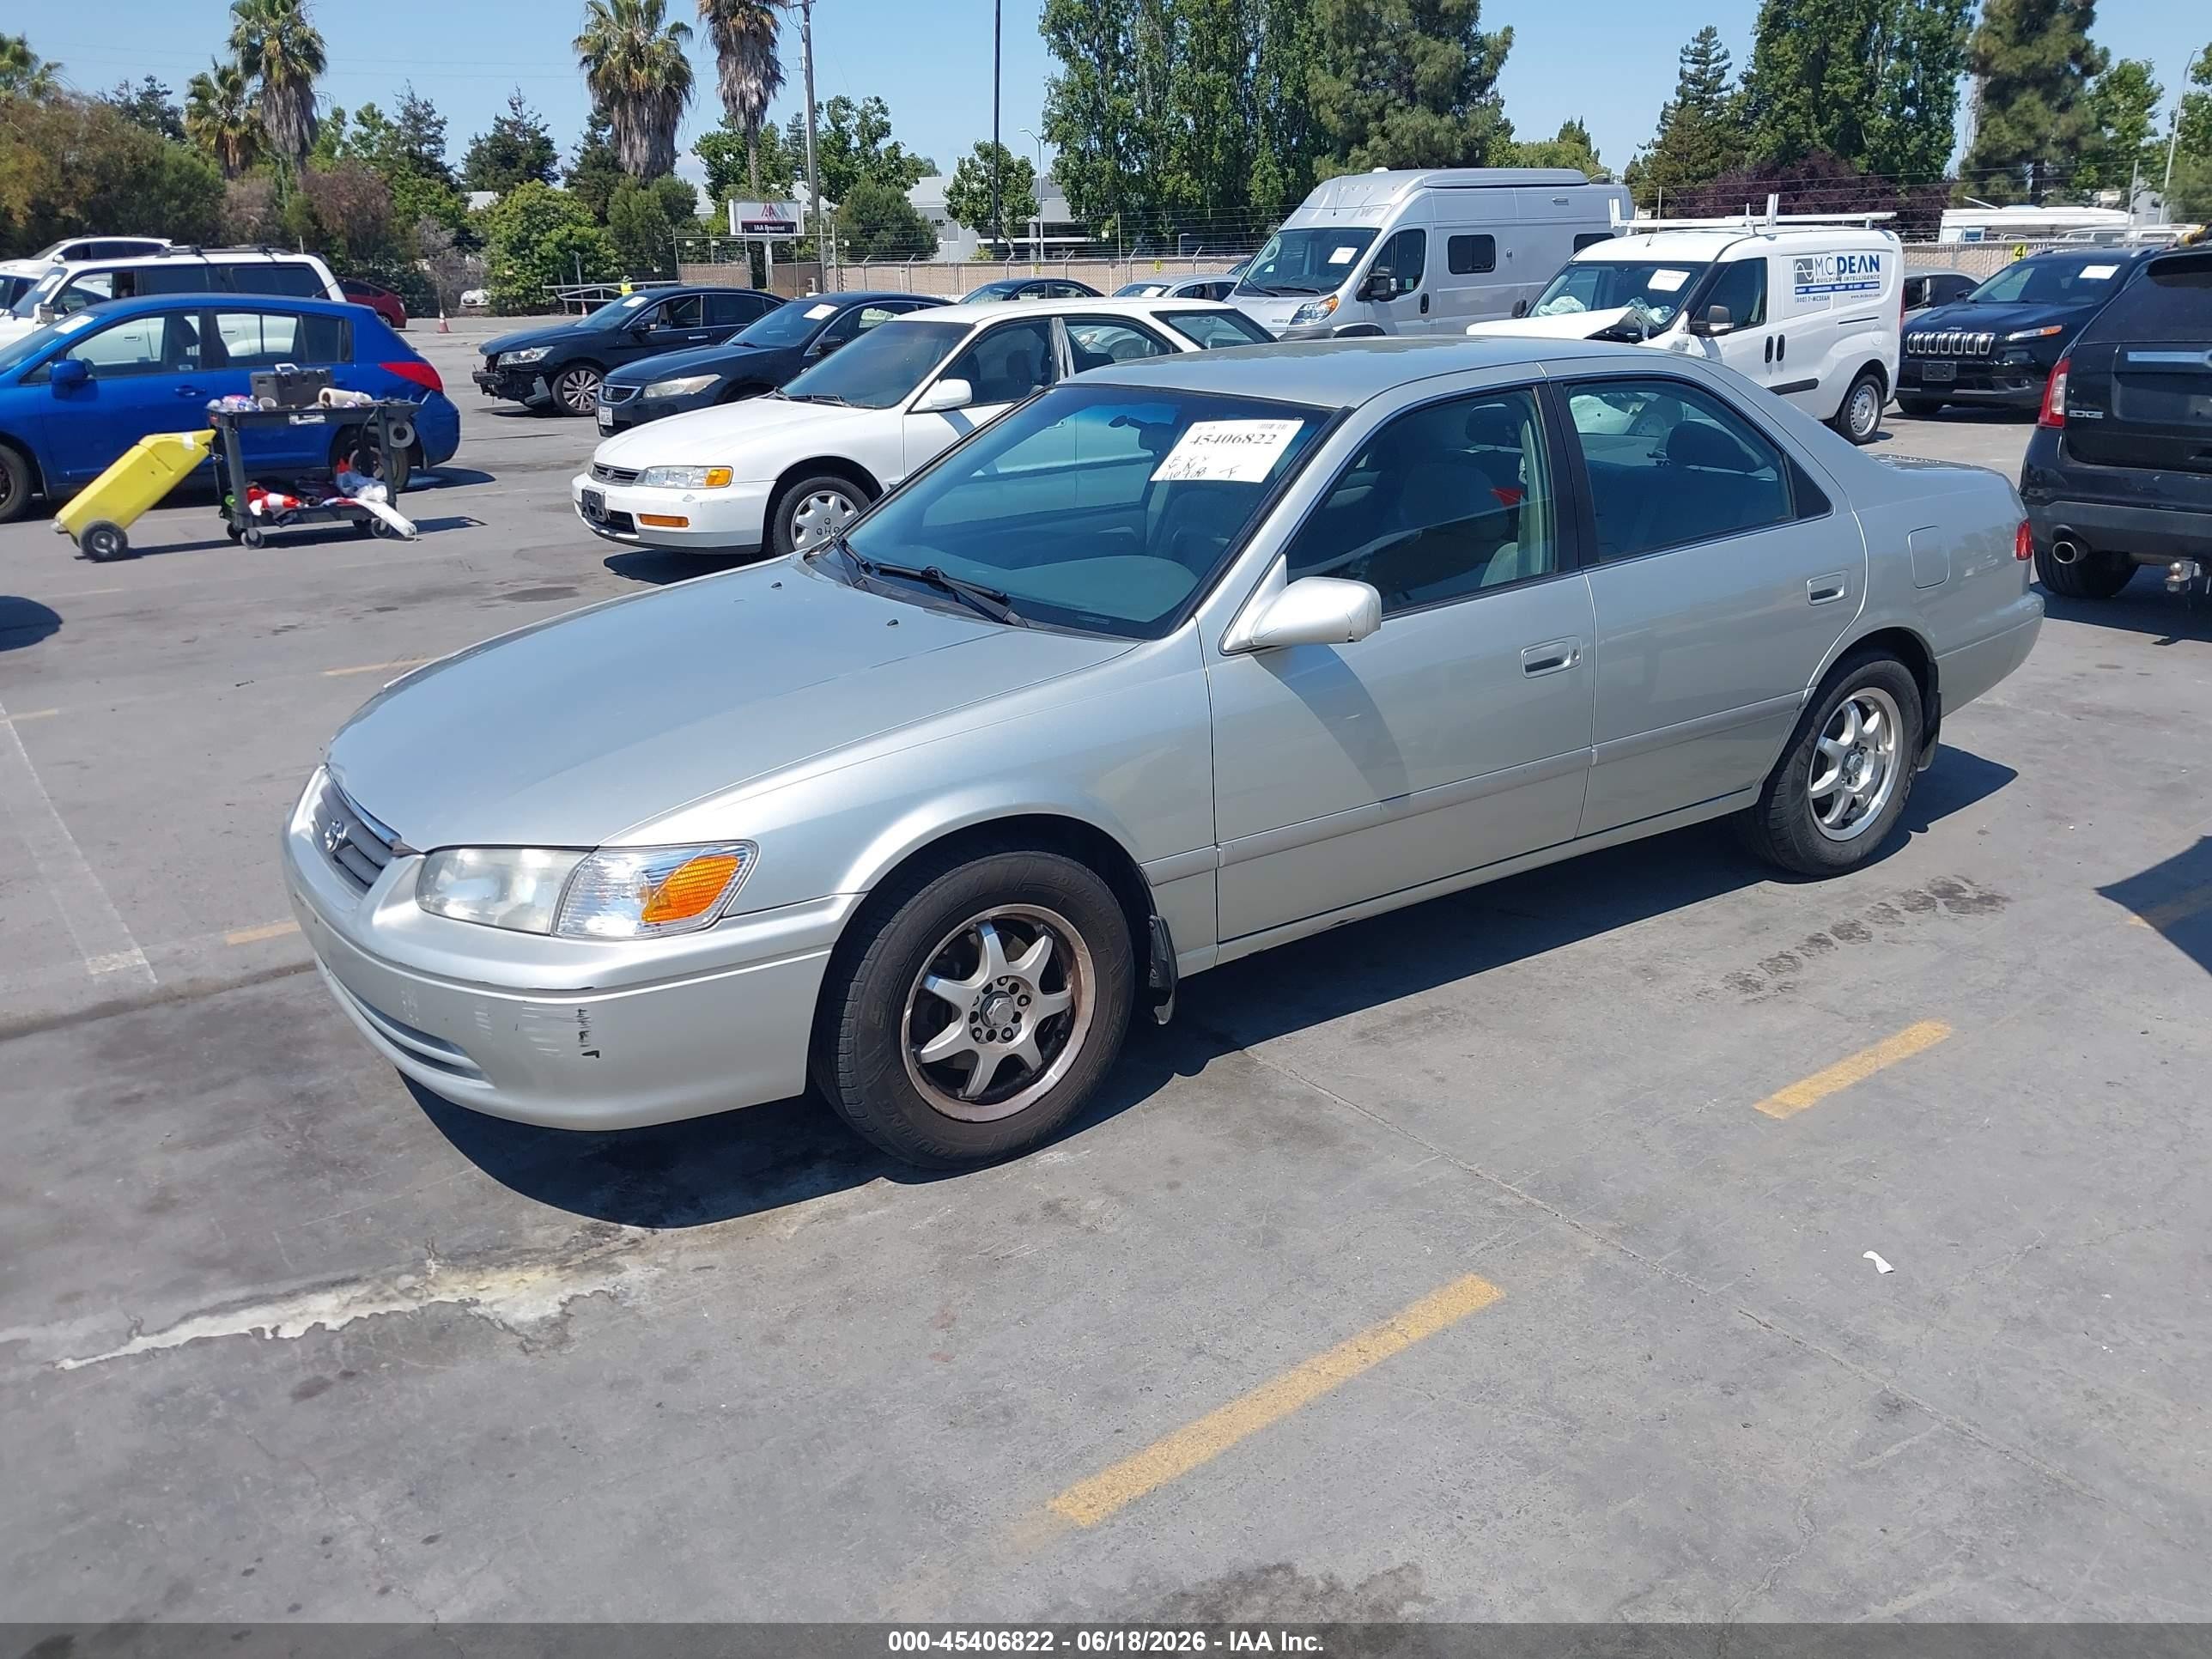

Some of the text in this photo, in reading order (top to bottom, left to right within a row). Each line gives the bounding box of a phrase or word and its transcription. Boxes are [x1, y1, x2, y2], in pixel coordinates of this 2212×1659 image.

[2014, 245, 2024, 257] 4
[1837, 254, 1880, 274] DEAN
[1189, 433, 1278, 445] 45406822
